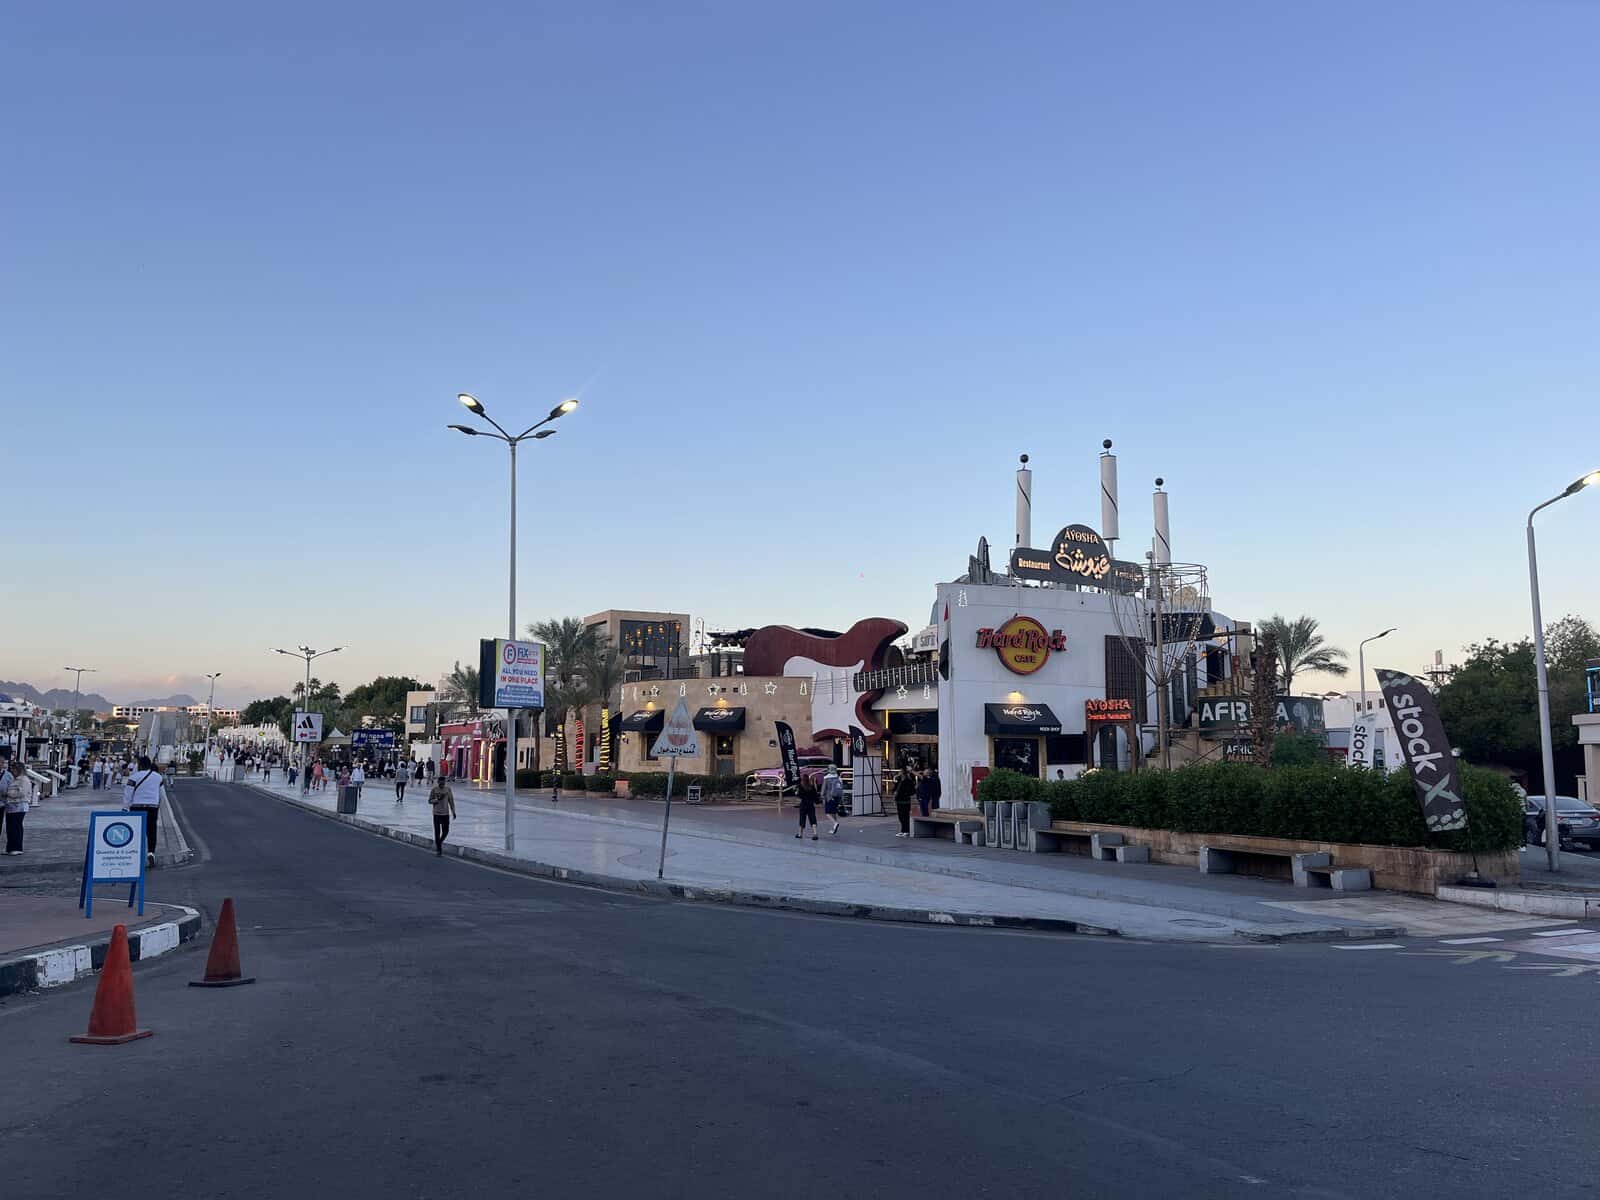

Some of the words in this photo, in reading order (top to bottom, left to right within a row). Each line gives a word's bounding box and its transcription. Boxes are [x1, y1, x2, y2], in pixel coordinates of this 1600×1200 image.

[1064, 528, 1099, 544] AYOSHA
[1018, 558, 1051, 570] Restaurant
[976, 627, 1024, 649] Hard
[1026, 629, 1067, 654] Rock
[1087, 699, 1131, 710] AYOSHA
[1201, 702, 1290, 721] AFRIA
